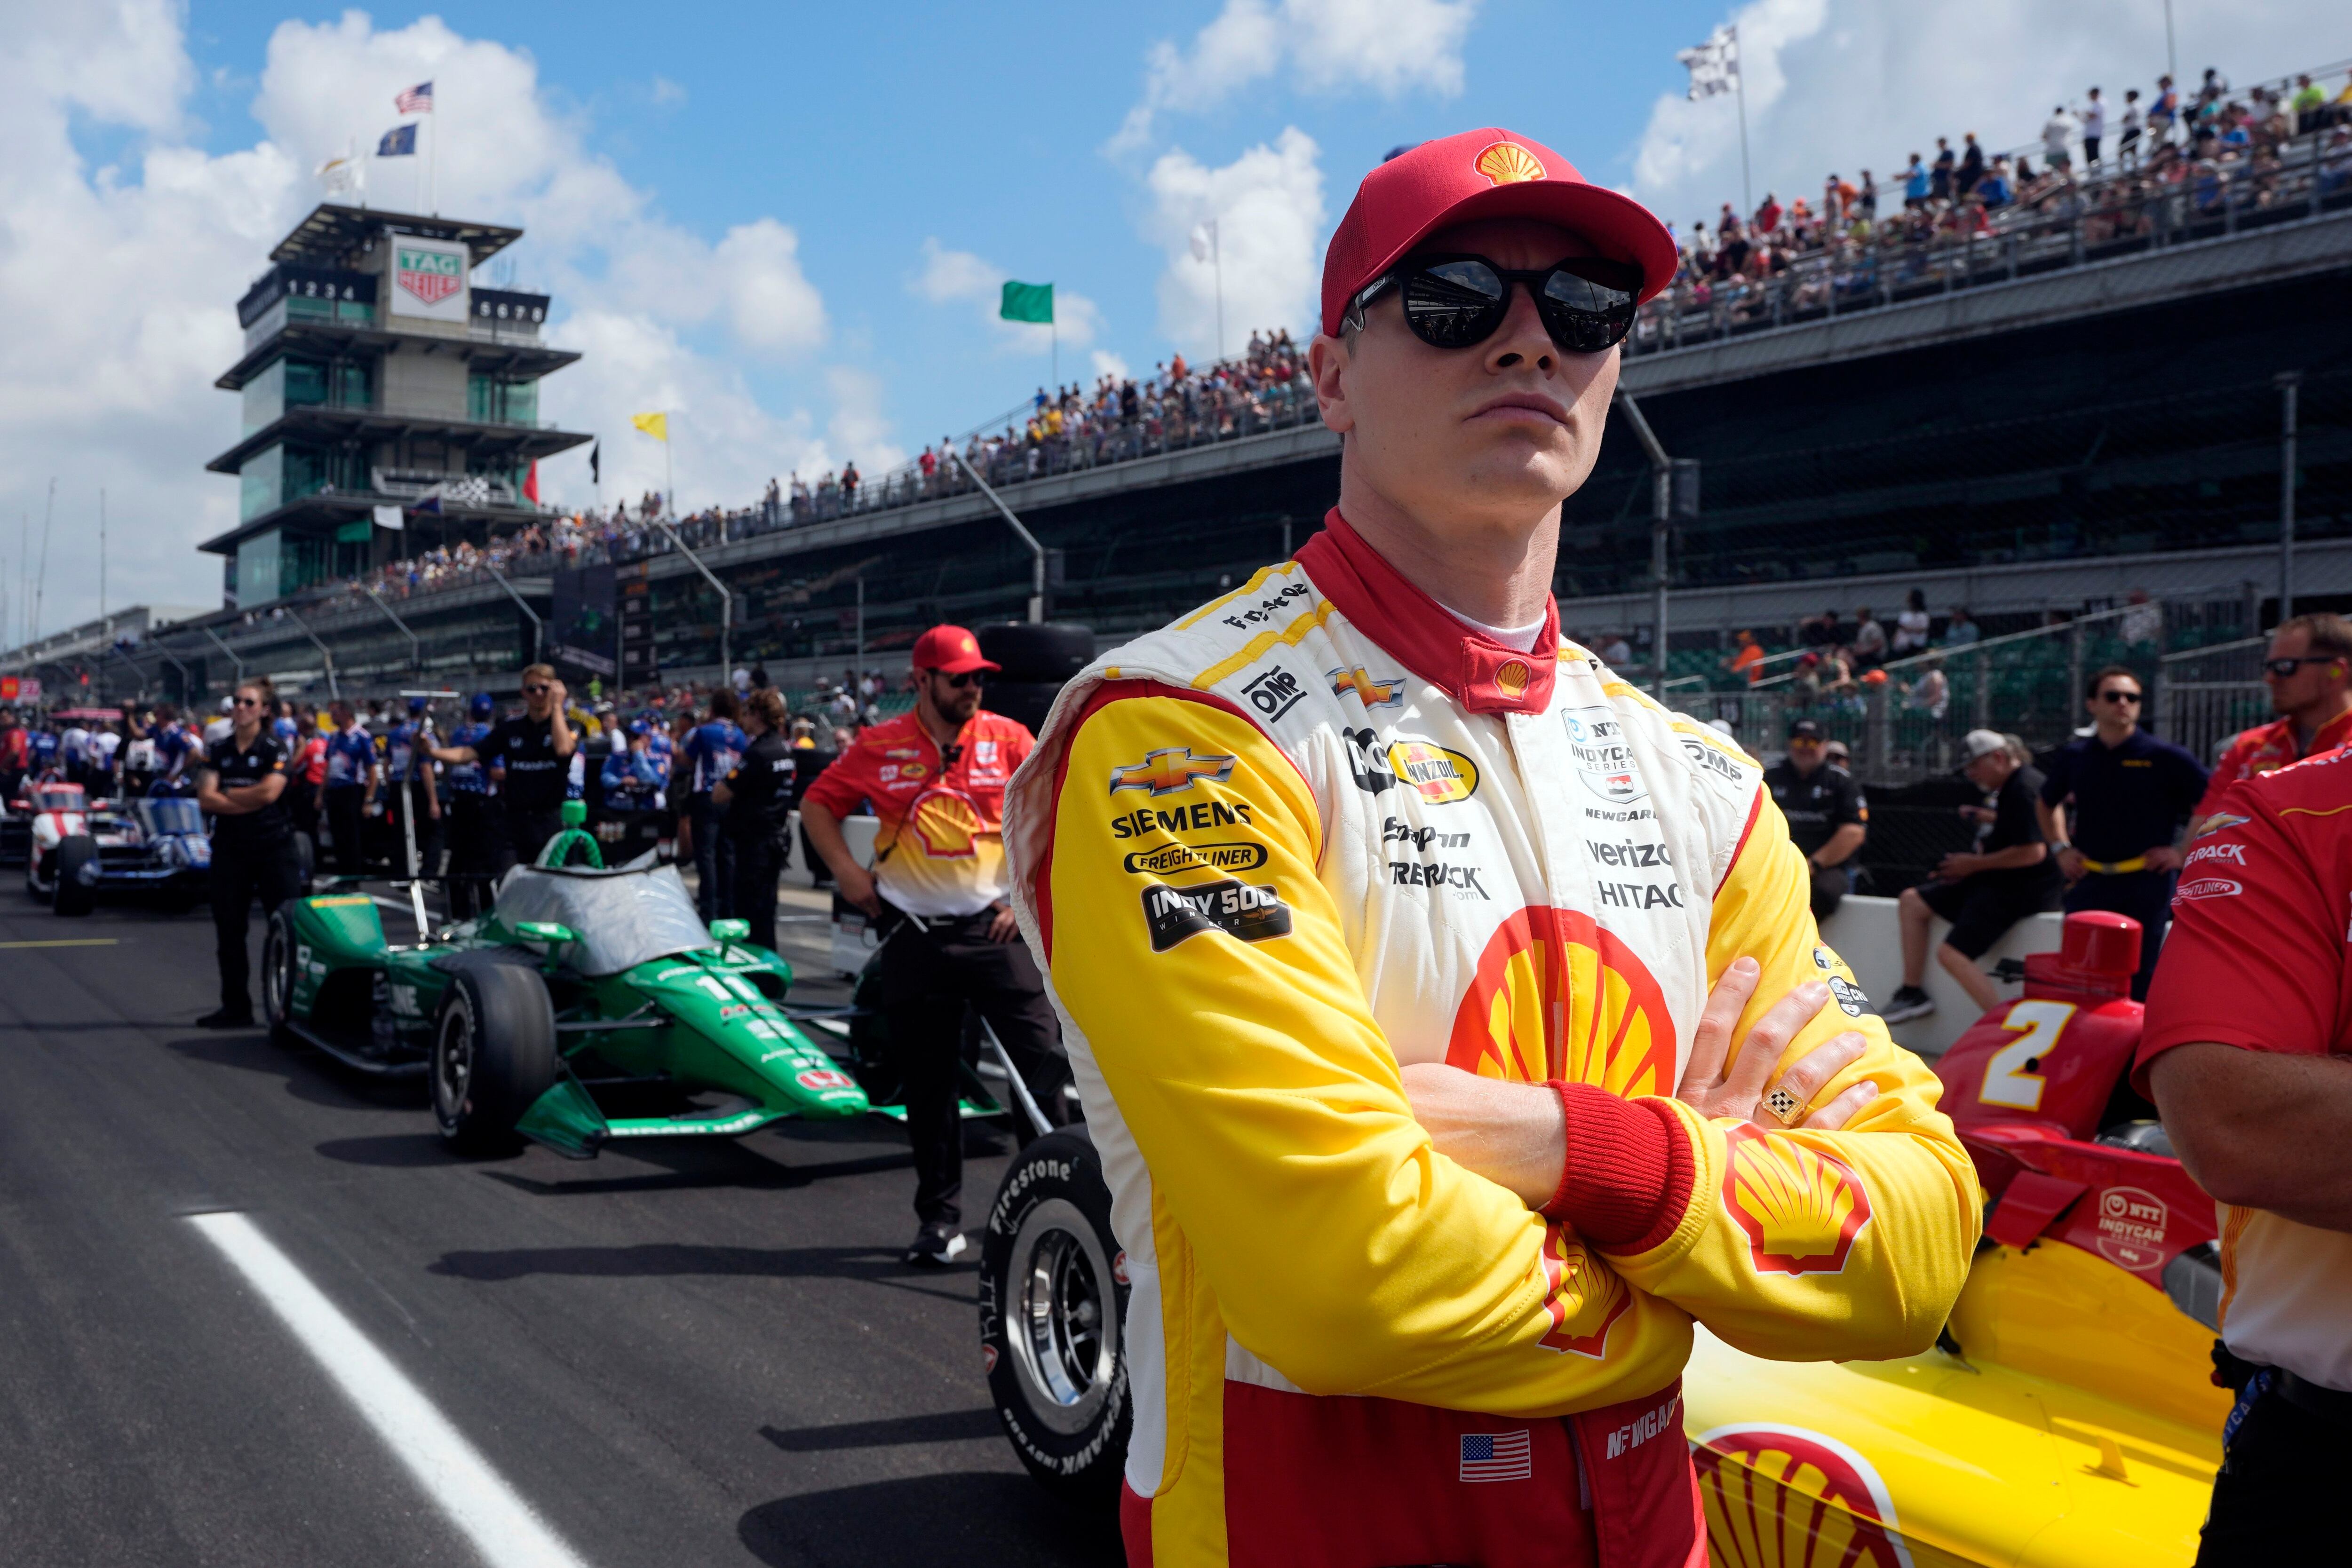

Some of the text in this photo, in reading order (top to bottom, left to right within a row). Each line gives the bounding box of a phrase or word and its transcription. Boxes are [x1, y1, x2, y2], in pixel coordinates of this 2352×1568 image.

[405, 250, 458, 276] TAG
[288, 279, 354, 301] 1 2 3 4
[400, 271, 460, 303] HEUER
[515, 306, 525, 320] 7
[1251, 673, 1300, 714] OMP
[1571, 743, 1635, 762] INDYCA
[1587, 761, 1636, 771] SERIES
[1684, 744, 1743, 780] OMP
[1111, 801, 1252, 838] SIEMENS
[1586, 839, 1671, 867] verizo
[1152, 886, 1277, 919] INDY 500
[1597, 880, 1684, 910] HITAC
[1159, 911, 1240, 931] WINER
[696, 975, 757, 1000] 11
[1978, 998, 2078, 1113] 2
[990, 1159, 1071, 1235] Firestone
[2129, 1203, 2161, 1221] NTT
[2098, 1217, 2165, 1243] INDYCAR
[1606, 1397, 1677, 1460] NEWGAR
